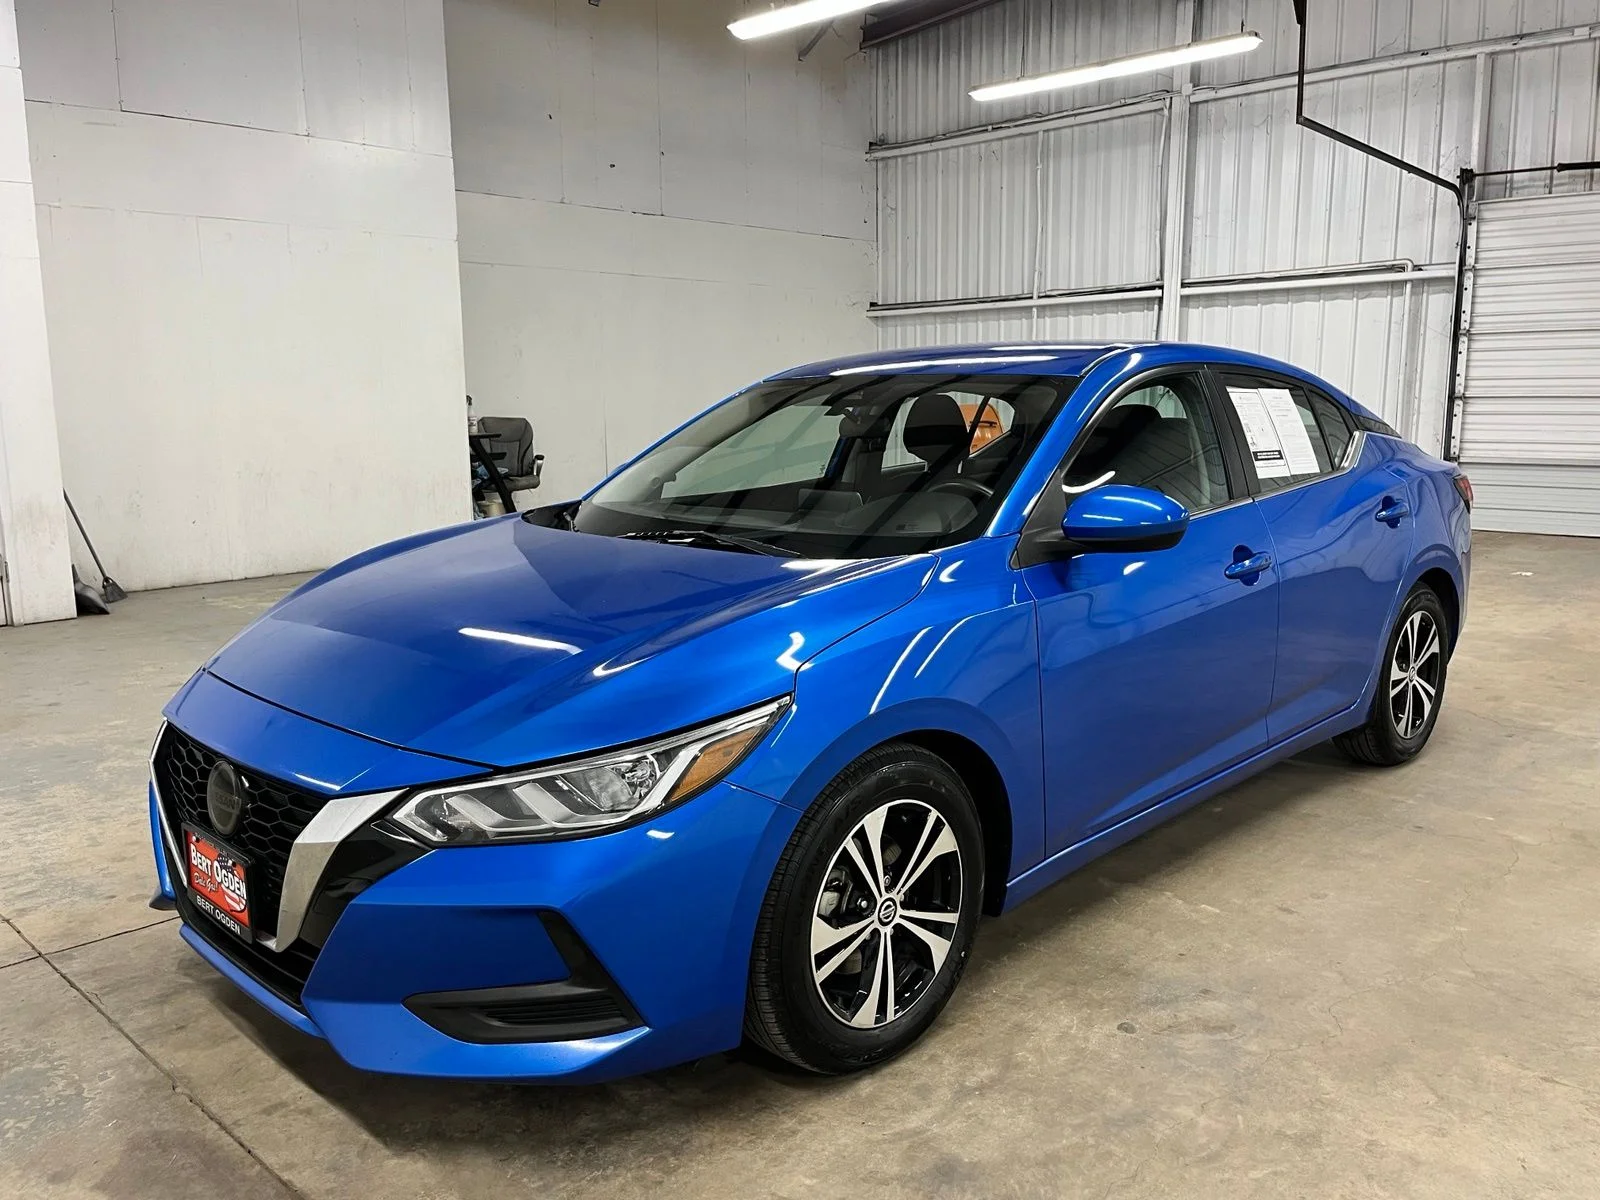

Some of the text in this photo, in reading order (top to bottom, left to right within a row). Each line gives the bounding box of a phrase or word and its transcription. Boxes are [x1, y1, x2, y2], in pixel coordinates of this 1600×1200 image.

[190, 843, 247, 900] BERT OGDEN
[196, 895, 241, 935] BERT OGDEN
